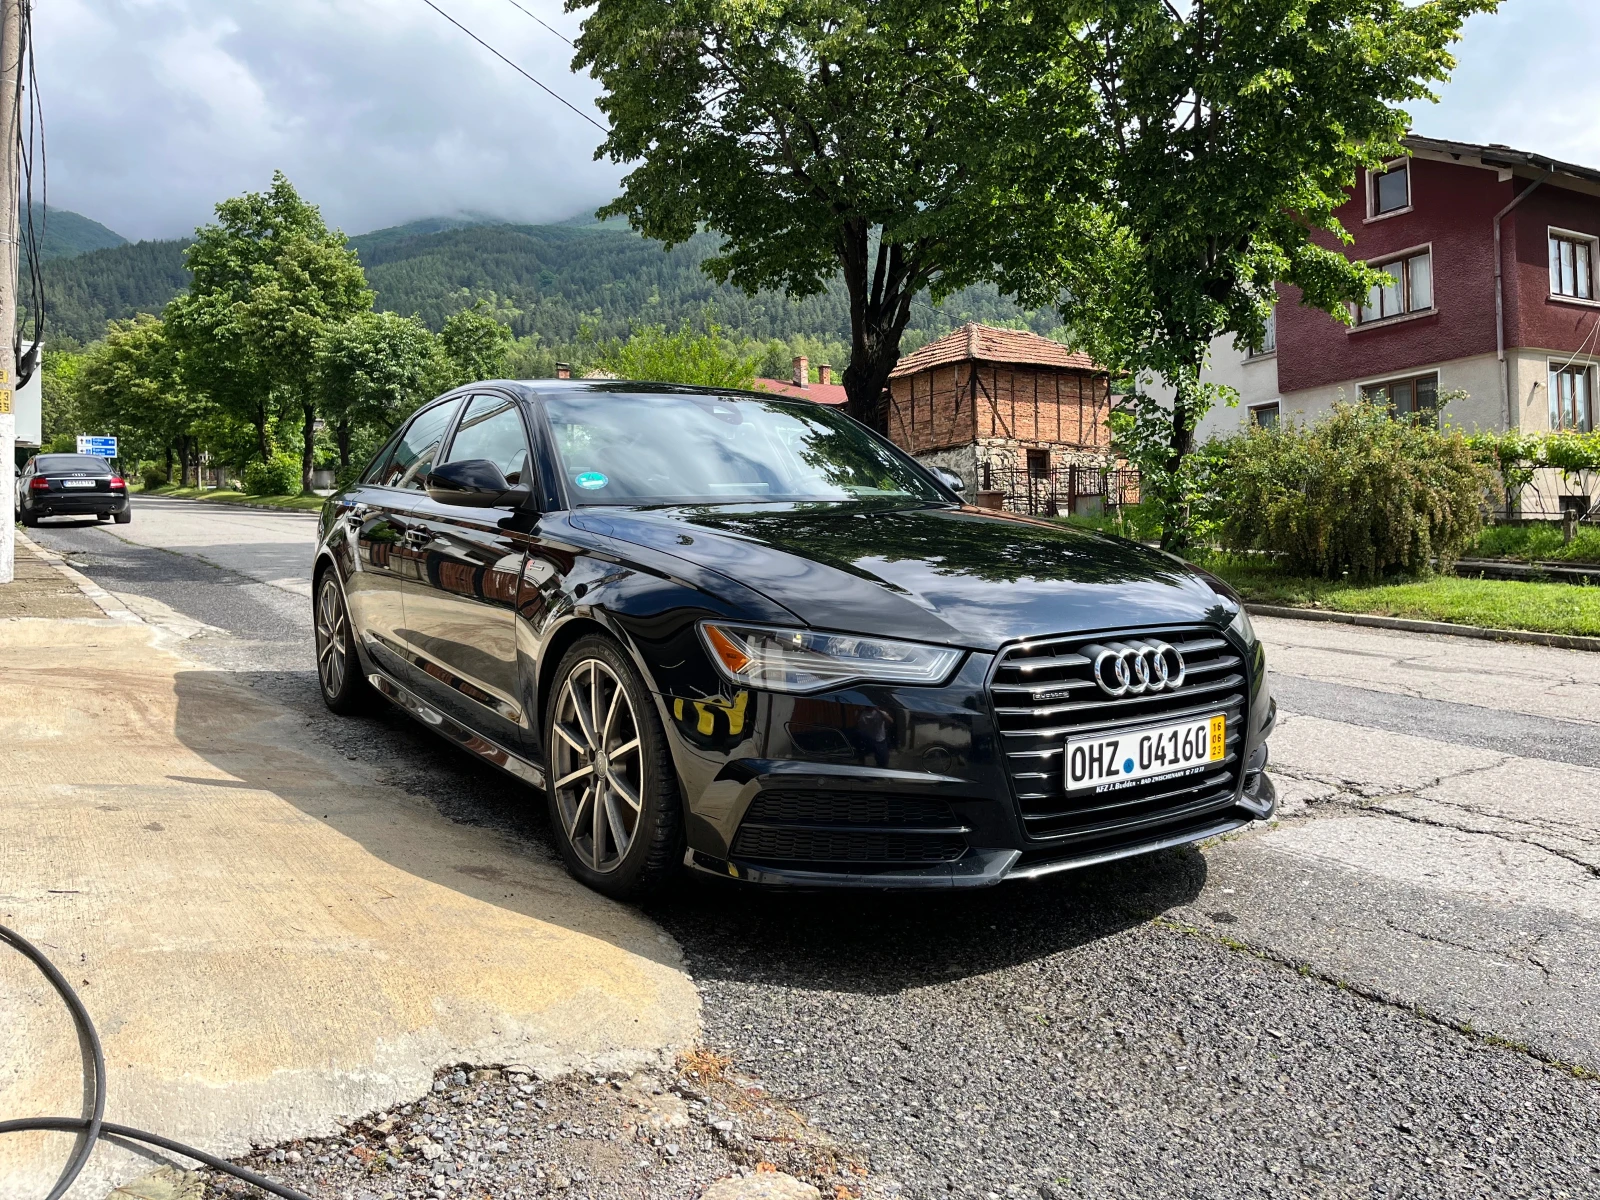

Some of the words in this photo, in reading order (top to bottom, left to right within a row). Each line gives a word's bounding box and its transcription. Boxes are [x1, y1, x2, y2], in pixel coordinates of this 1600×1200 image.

[1213, 722, 1222, 731] 16
[1212, 734, 1222, 743] 06
[1071, 740, 1120, 781] OHZ
[1139, 725, 1206, 770] 04160
[1212, 746, 1222, 755] 23
[1096, 784, 1109, 793] KFZ
